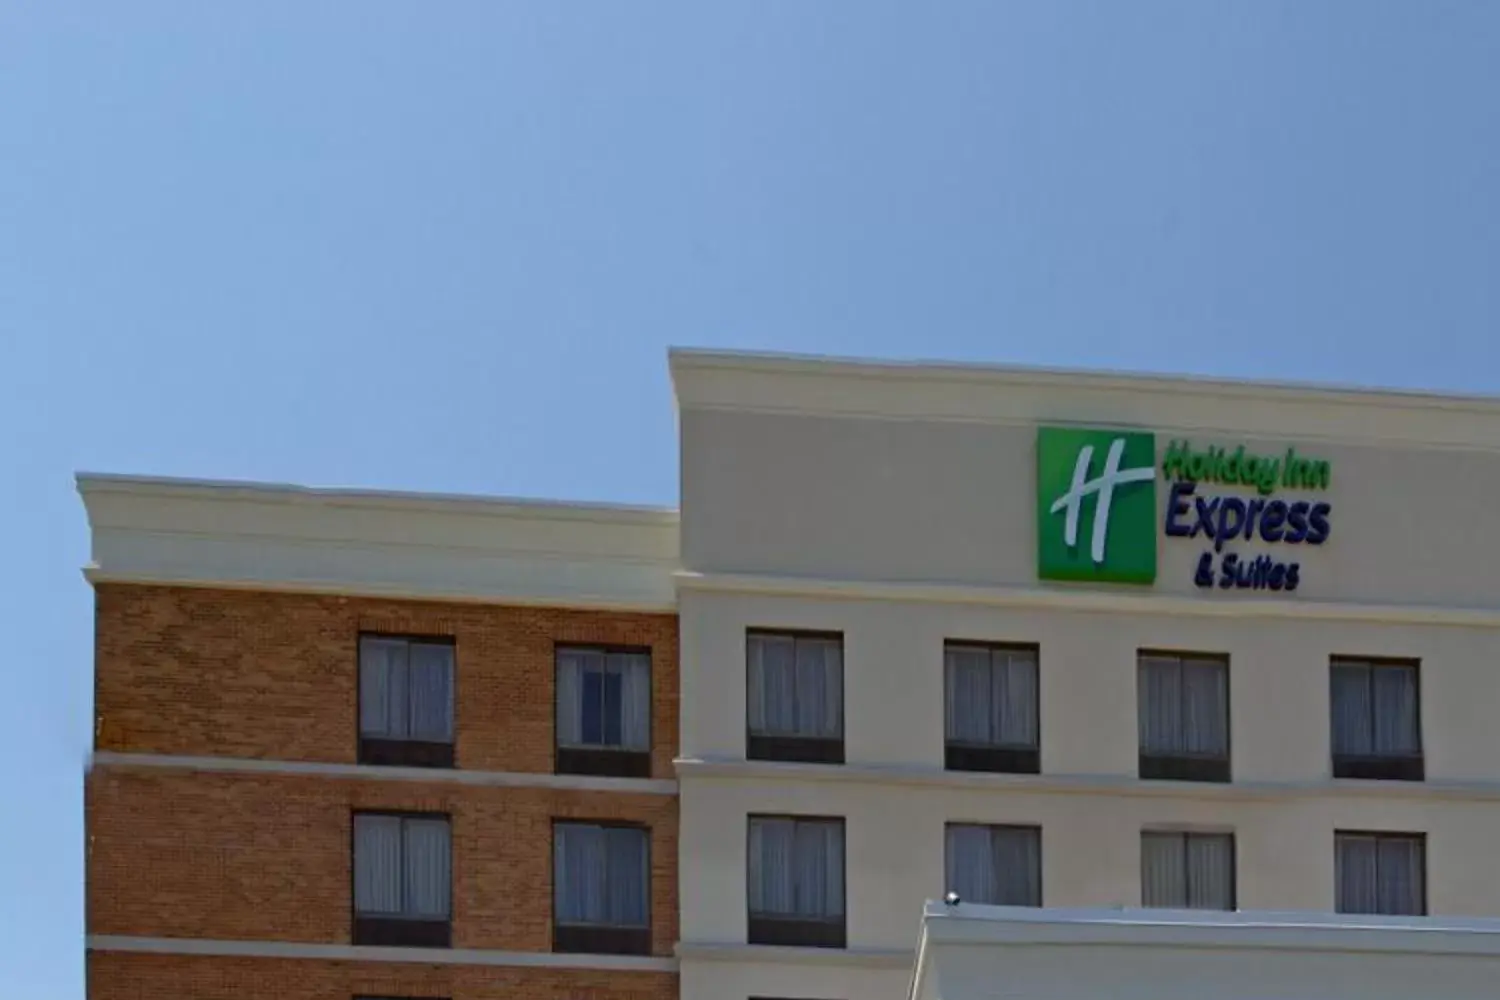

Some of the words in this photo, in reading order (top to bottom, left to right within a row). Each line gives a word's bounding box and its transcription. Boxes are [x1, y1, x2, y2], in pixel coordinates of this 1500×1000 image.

[1163, 440, 1280, 495] Holiday
[1283, 447, 1331, 490] Inn
[1164, 482, 1331, 552] Express
[1194, 552, 1214, 589] &
[1218, 555, 1299, 591] Suites
